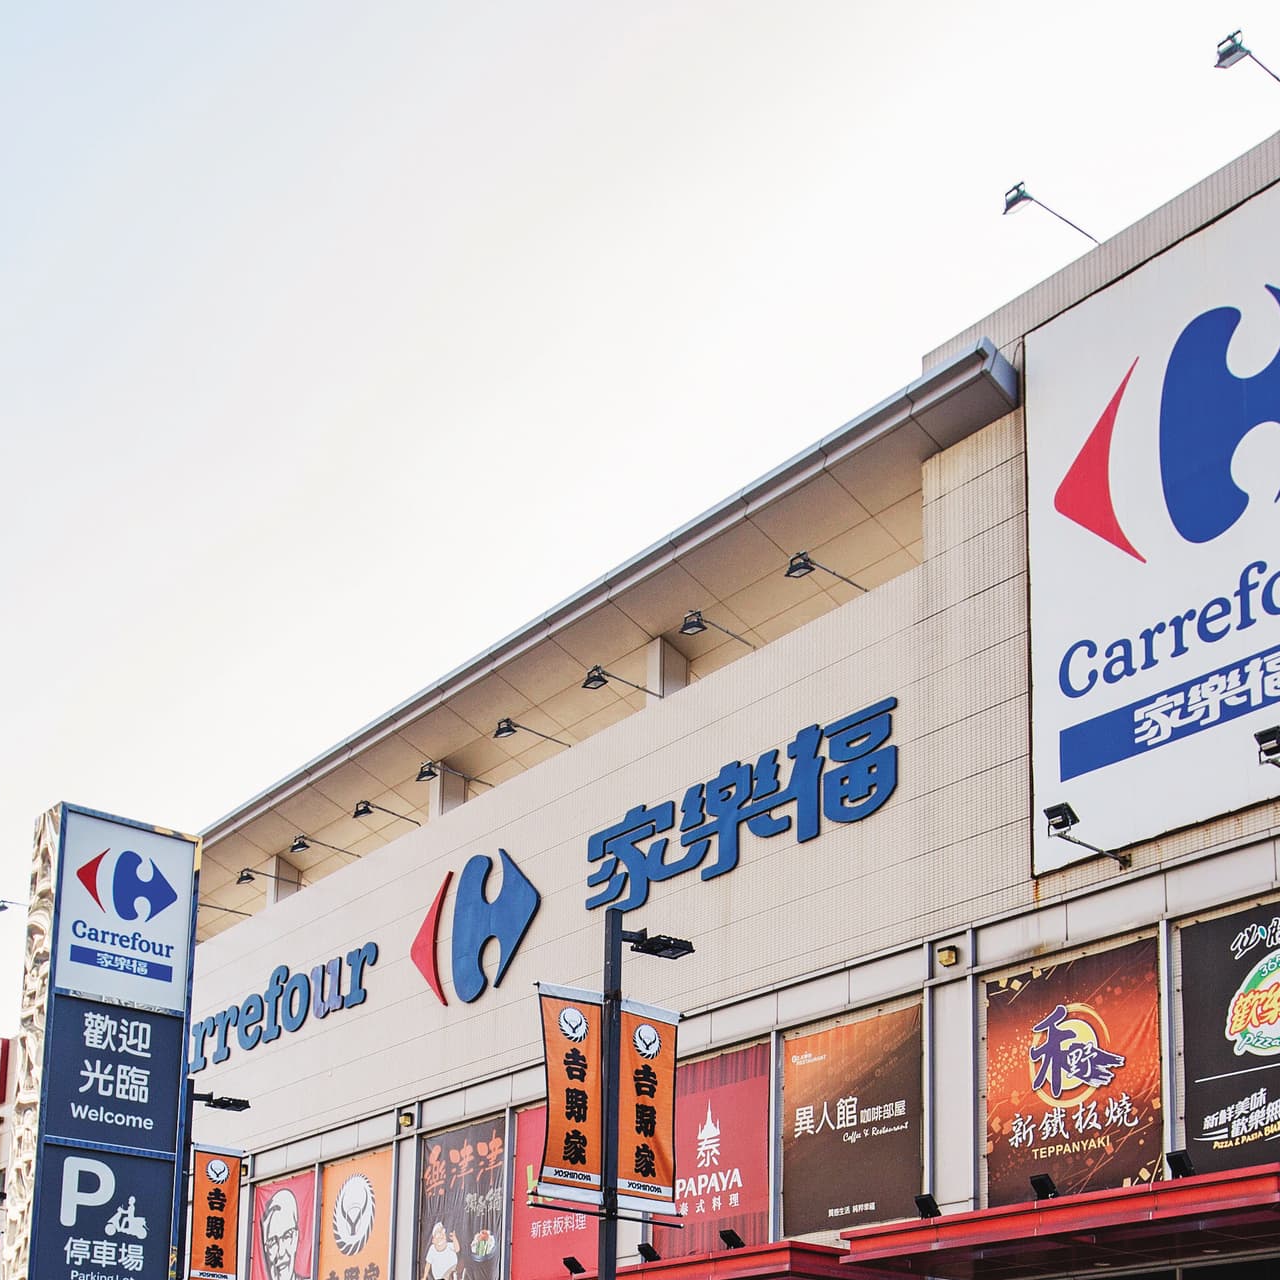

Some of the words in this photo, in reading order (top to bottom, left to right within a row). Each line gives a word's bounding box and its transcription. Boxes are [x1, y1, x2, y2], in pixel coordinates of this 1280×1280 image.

[586, 697, 898, 912] 家樂福
[71, 920, 174, 958] Carrefour
[97, 952, 148, 975] 家樂福
[187, 939, 379, 1074] rrefour
[83, 1011, 151, 1058] 歡迎
[79, 1059, 151, 1104] 光臨
[70, 1102, 154, 1131] Welcome
[794, 1095, 858, 1138] 異人館
[860, 1100, 906, 1124] 咖啡部屋
[1009, 1092, 1139, 1150] 新鐵板燒
[1203, 1087, 1267, 1130] 新鮮美味
[871, 1121, 909, 1136] Restaurant
[1032, 1136, 1110, 1160] TEPPANYAKI
[60, 1156, 116, 1227] P
[553, 1169, 591, 1182] YOSHINOYA
[627, 1181, 662, 1194] YOSHINOYA
[676, 1167, 743, 1199] PAPAYA
[679, 1192, 740, 1215] 泰式料理
[64, 1236, 144, 1272] 停車場
